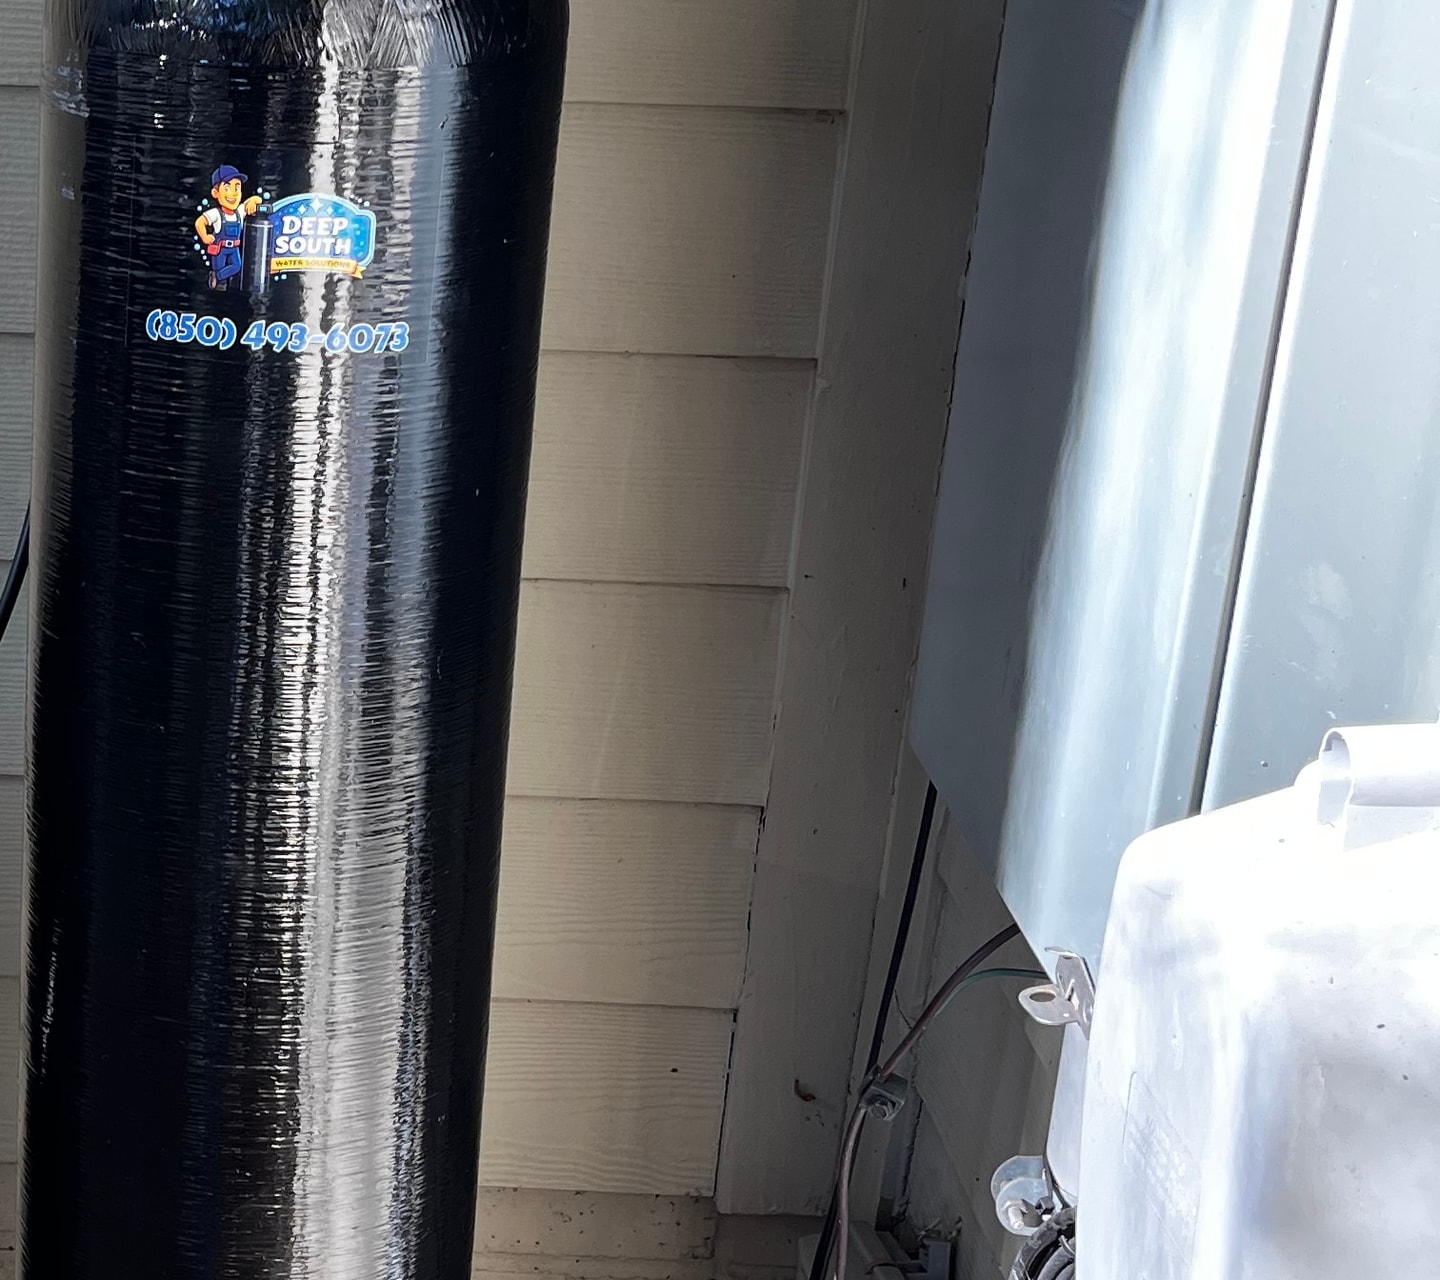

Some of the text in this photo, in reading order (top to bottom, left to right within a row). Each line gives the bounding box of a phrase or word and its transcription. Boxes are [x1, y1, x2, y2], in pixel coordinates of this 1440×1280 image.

[282, 216, 349, 235] DEEP
[275, 235, 351, 255] SOUTH
[305, 260, 351, 268] SOLUTIONS
[146, 309, 410, 354] (850) 493-6073
